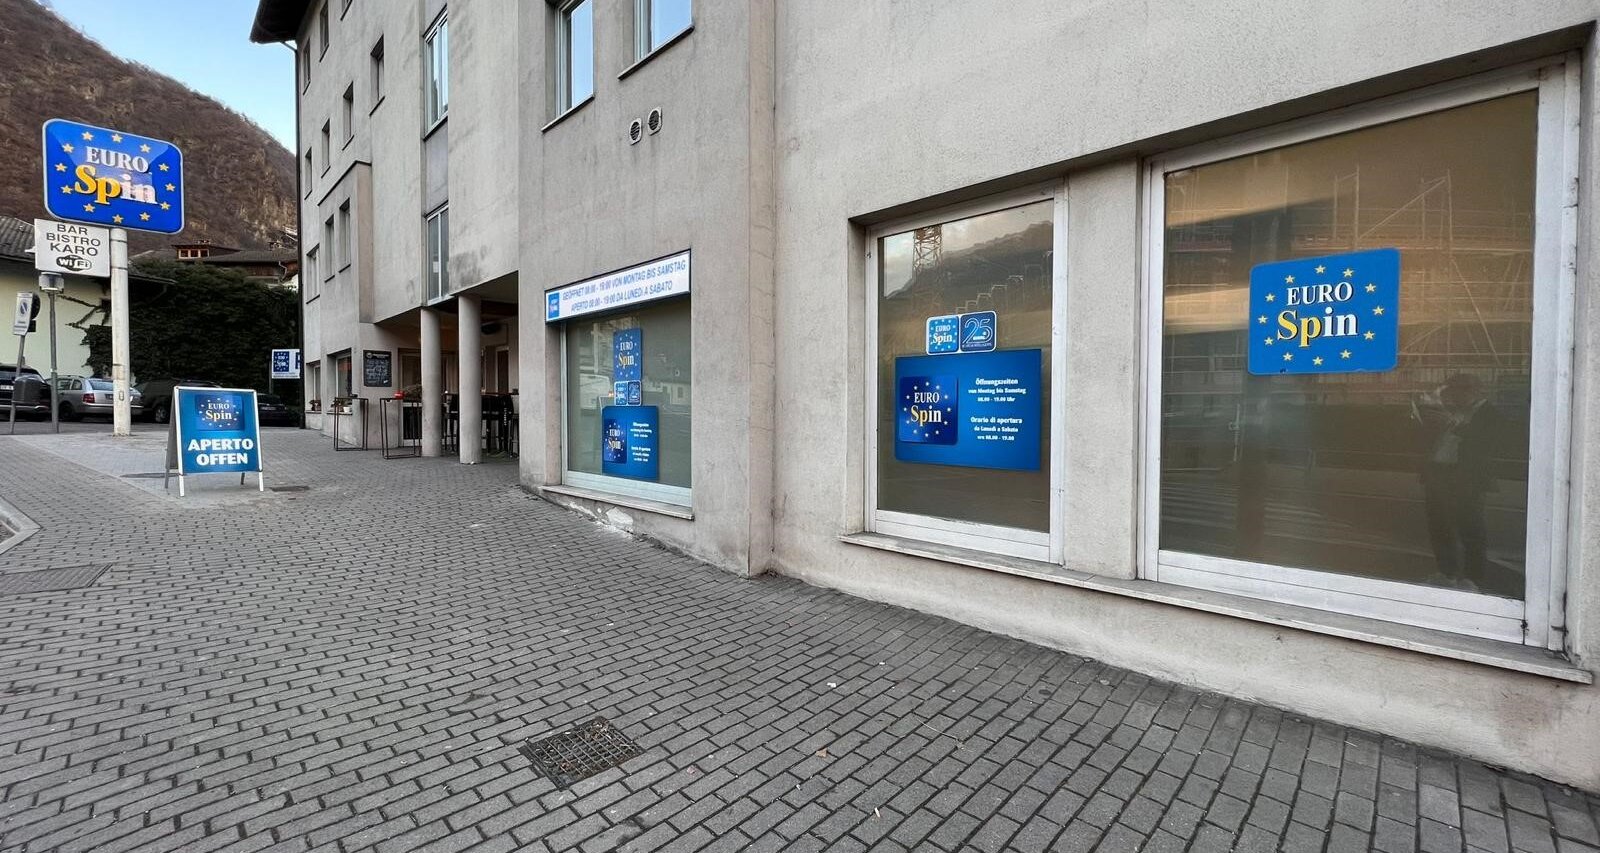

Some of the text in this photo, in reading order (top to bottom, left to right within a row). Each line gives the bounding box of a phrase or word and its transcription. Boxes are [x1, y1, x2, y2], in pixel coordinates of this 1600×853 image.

[86, 146, 149, 173] EURO
[75, 165, 158, 205] Spin
[57, 224, 88, 235] BAR
[46, 232, 101, 247] BISTRO
[50, 242, 98, 256] KARO
[612, 276, 622, 289] VON
[623, 270, 646, 286] MONTAG
[647, 267, 656, 280] BIS
[657, 259, 686, 277] SAMSTAG
[616, 291, 624, 302] DA
[643, 285, 648, 296] A
[649, 280, 673, 295] SABATO
[1287, 282, 1353, 306] EURO
[962, 317, 993, 344] 25
[1277, 307, 1358, 348] Spin
[932, 332, 953, 345] Spin
[914, 391, 940, 404] EURO
[205, 409, 233, 422] Spin
[910, 405, 942, 427] Spin
[188, 438, 254, 451] APERTO
[196, 453, 248, 466] OFFEN
